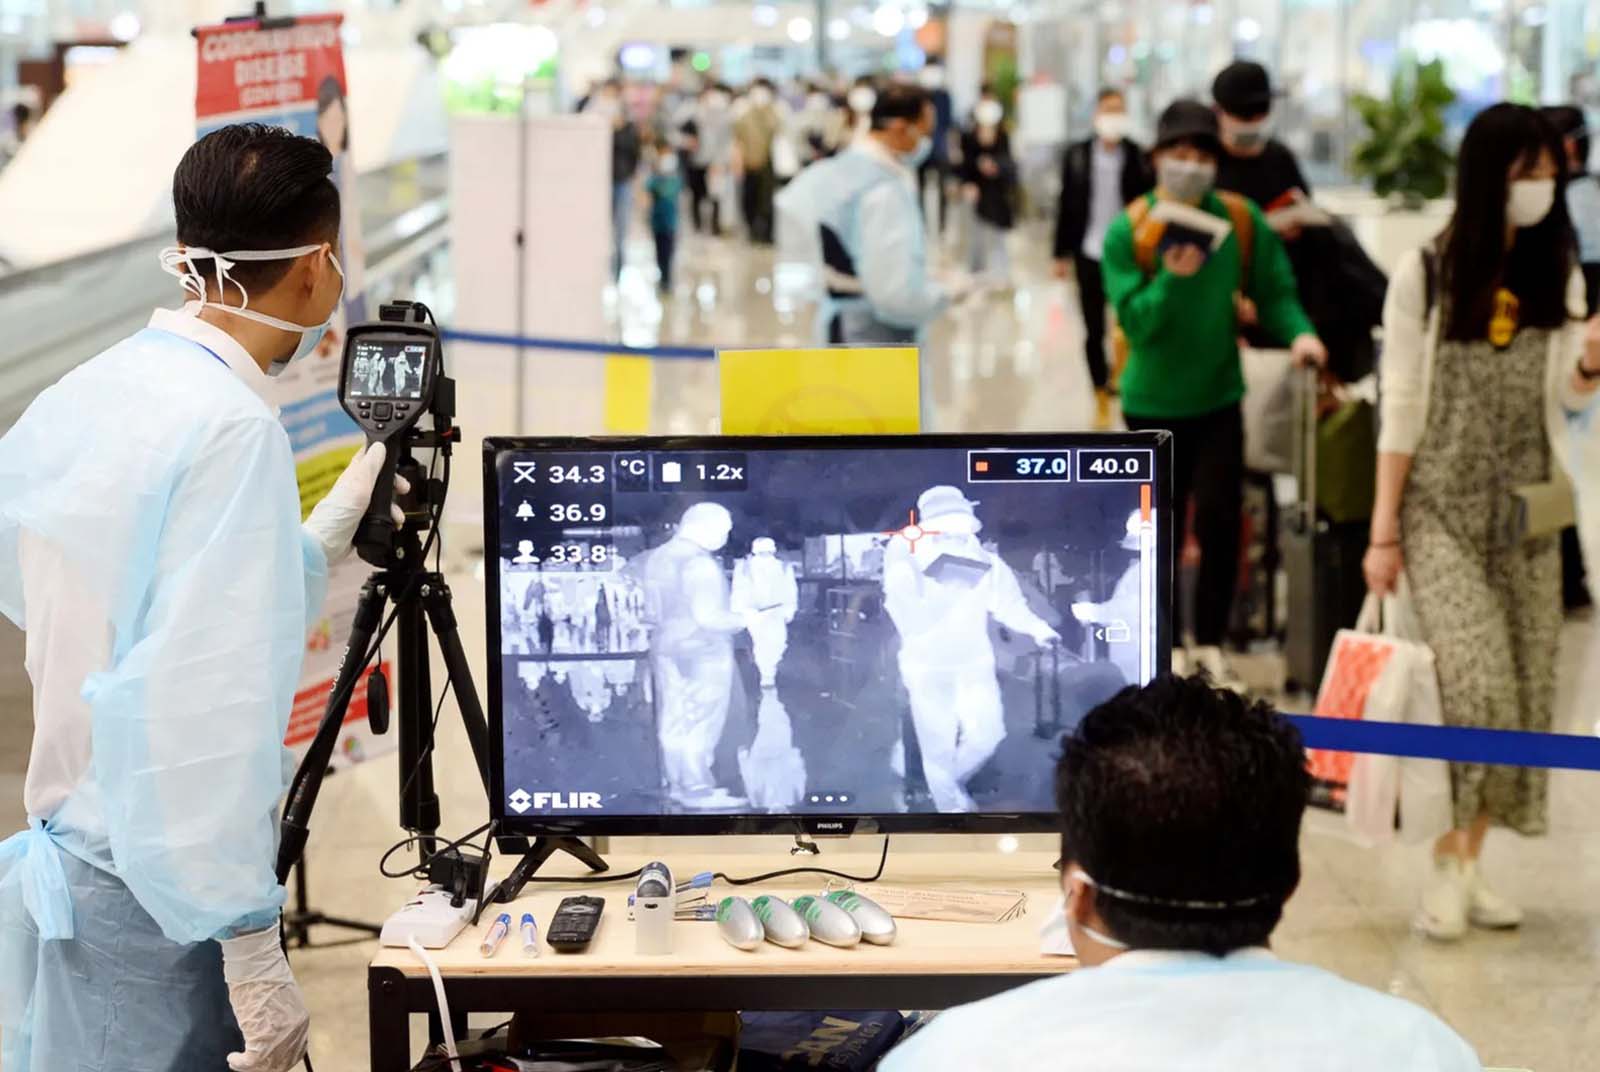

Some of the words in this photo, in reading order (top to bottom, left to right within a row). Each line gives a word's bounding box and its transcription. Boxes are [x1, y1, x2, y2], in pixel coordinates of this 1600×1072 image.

[549, 465, 605, 483] 34.3
[620, 459, 646, 475] °C
[696, 464, 744, 480] 1.2x
[1016, 457, 1066, 474] 37.0
[1089, 457, 1139, 474] 40.0
[549, 504, 606, 521] 36.9
[549, 544, 607, 562] 33.8
[533, 791, 604, 809] FLIR
